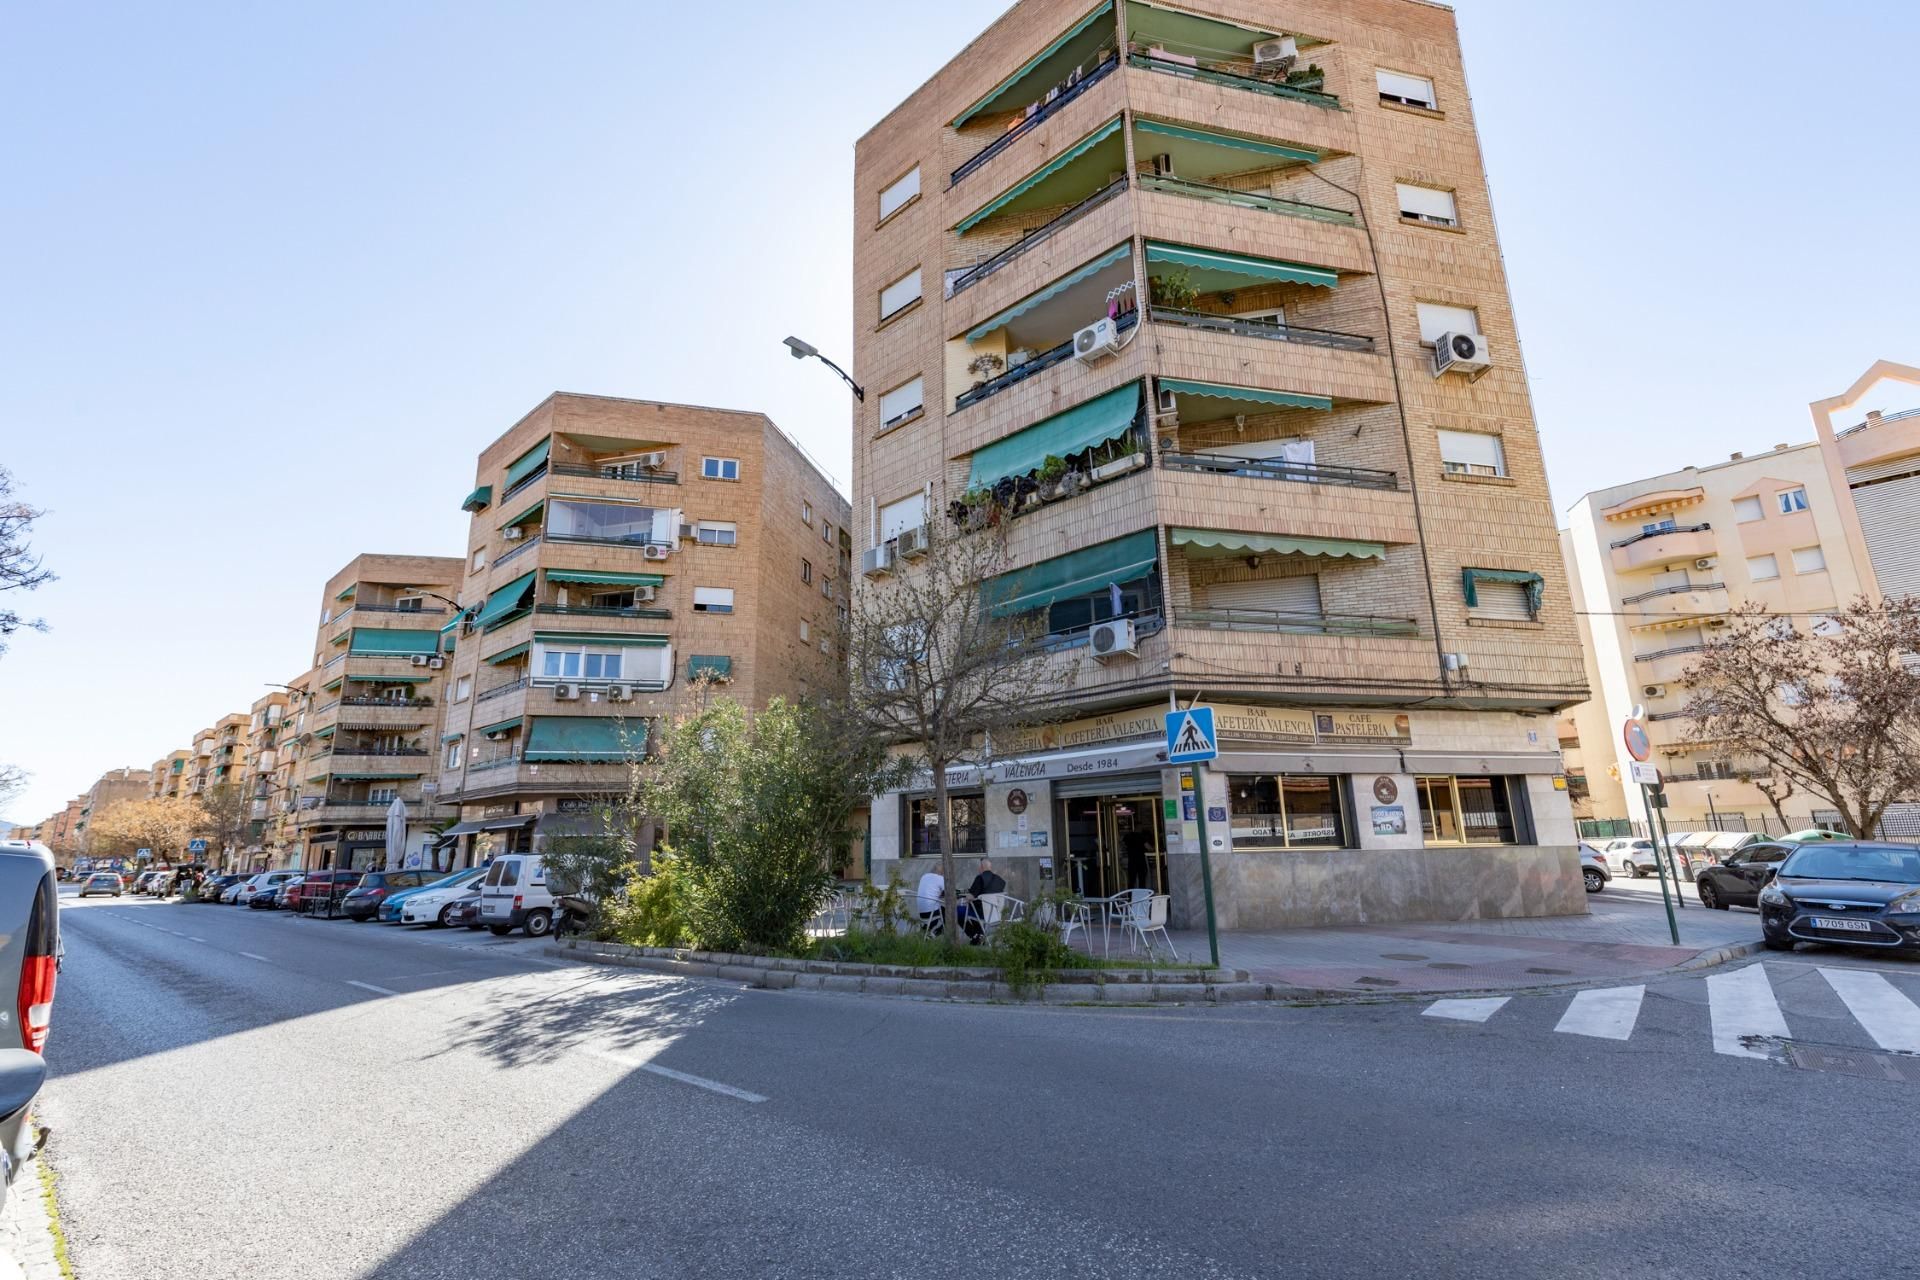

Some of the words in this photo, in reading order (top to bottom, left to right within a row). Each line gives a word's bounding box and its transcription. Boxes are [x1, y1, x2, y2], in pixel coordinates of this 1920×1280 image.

[1246, 707, 1268, 718] BAR
[1095, 715, 1114, 727] BAR
[1112, 717, 1159, 737] VALENCIA
[1215, 714, 1266, 732] AFETERÍA
[1266, 718, 1314, 734] VALENCIA
[1004, 762, 1047, 779] VALENCIA
[1066, 761, 1094, 773] Desde
[1096, 758, 1119, 769] 1984
[1819, 919, 1844, 929] 1709
[1846, 920, 1868, 930] GSN
